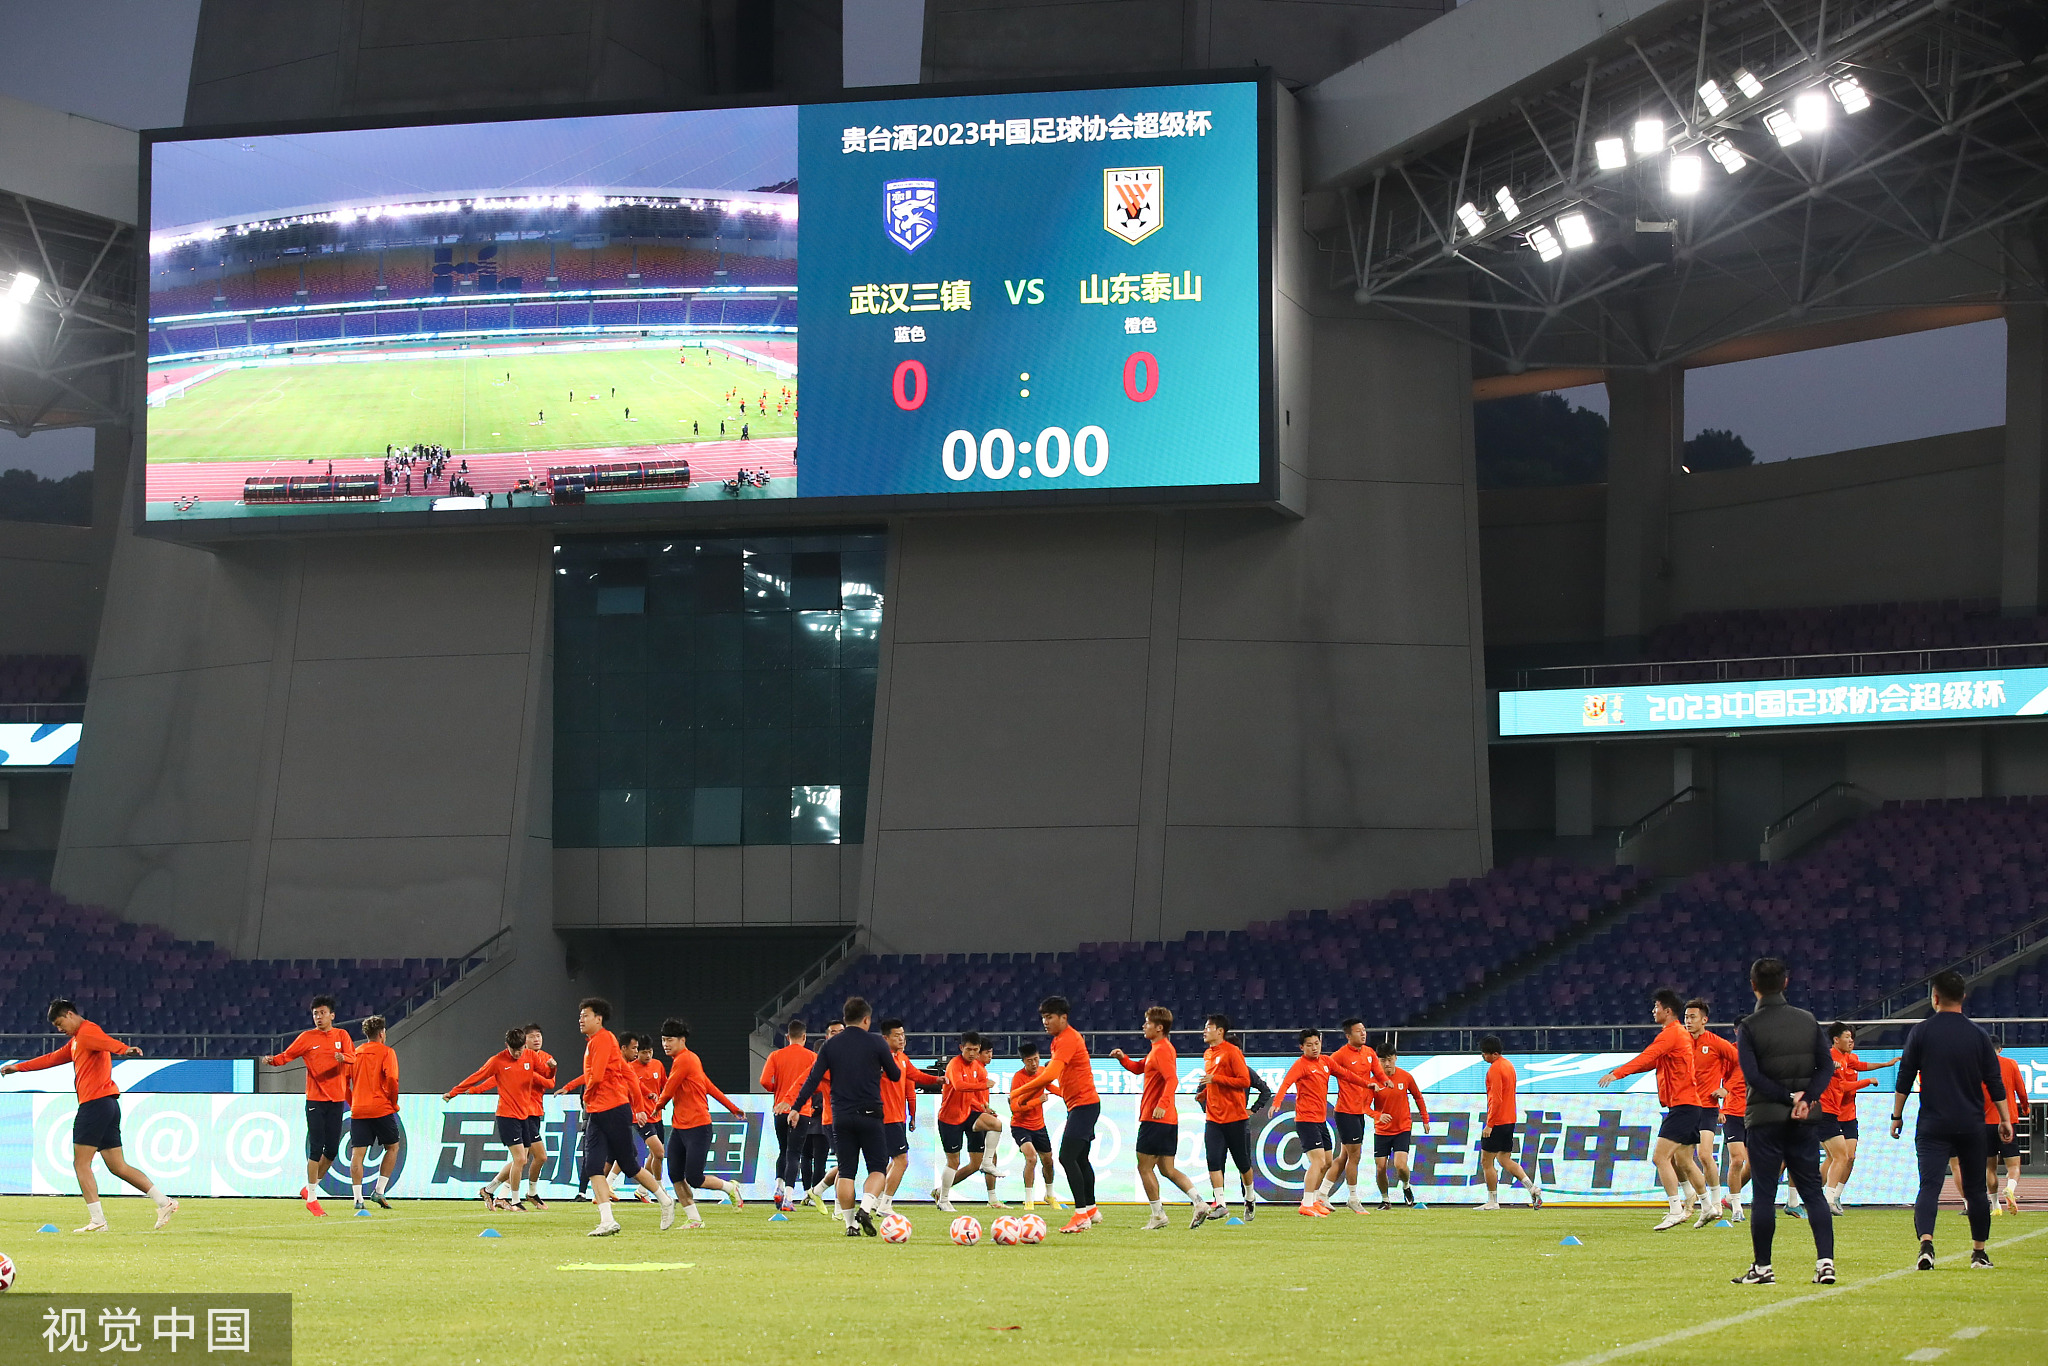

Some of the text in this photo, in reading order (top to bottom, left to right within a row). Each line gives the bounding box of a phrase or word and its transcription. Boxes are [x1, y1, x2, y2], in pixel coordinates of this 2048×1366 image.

[841, 109, 1213, 154] 贵台酒2023中国足球协会超级杯
[849, 270, 1202, 315] 武汉三镇 VS 山东泰山
[893, 316, 1158, 343] 蓝色 橙色
[891, 359, 929, 411] 0
[1122, 350, 1160, 403] 0
[941, 424, 1110, 481] 00:00
[1647, 679, 2007, 722] 2023中国足球协会超级杯
